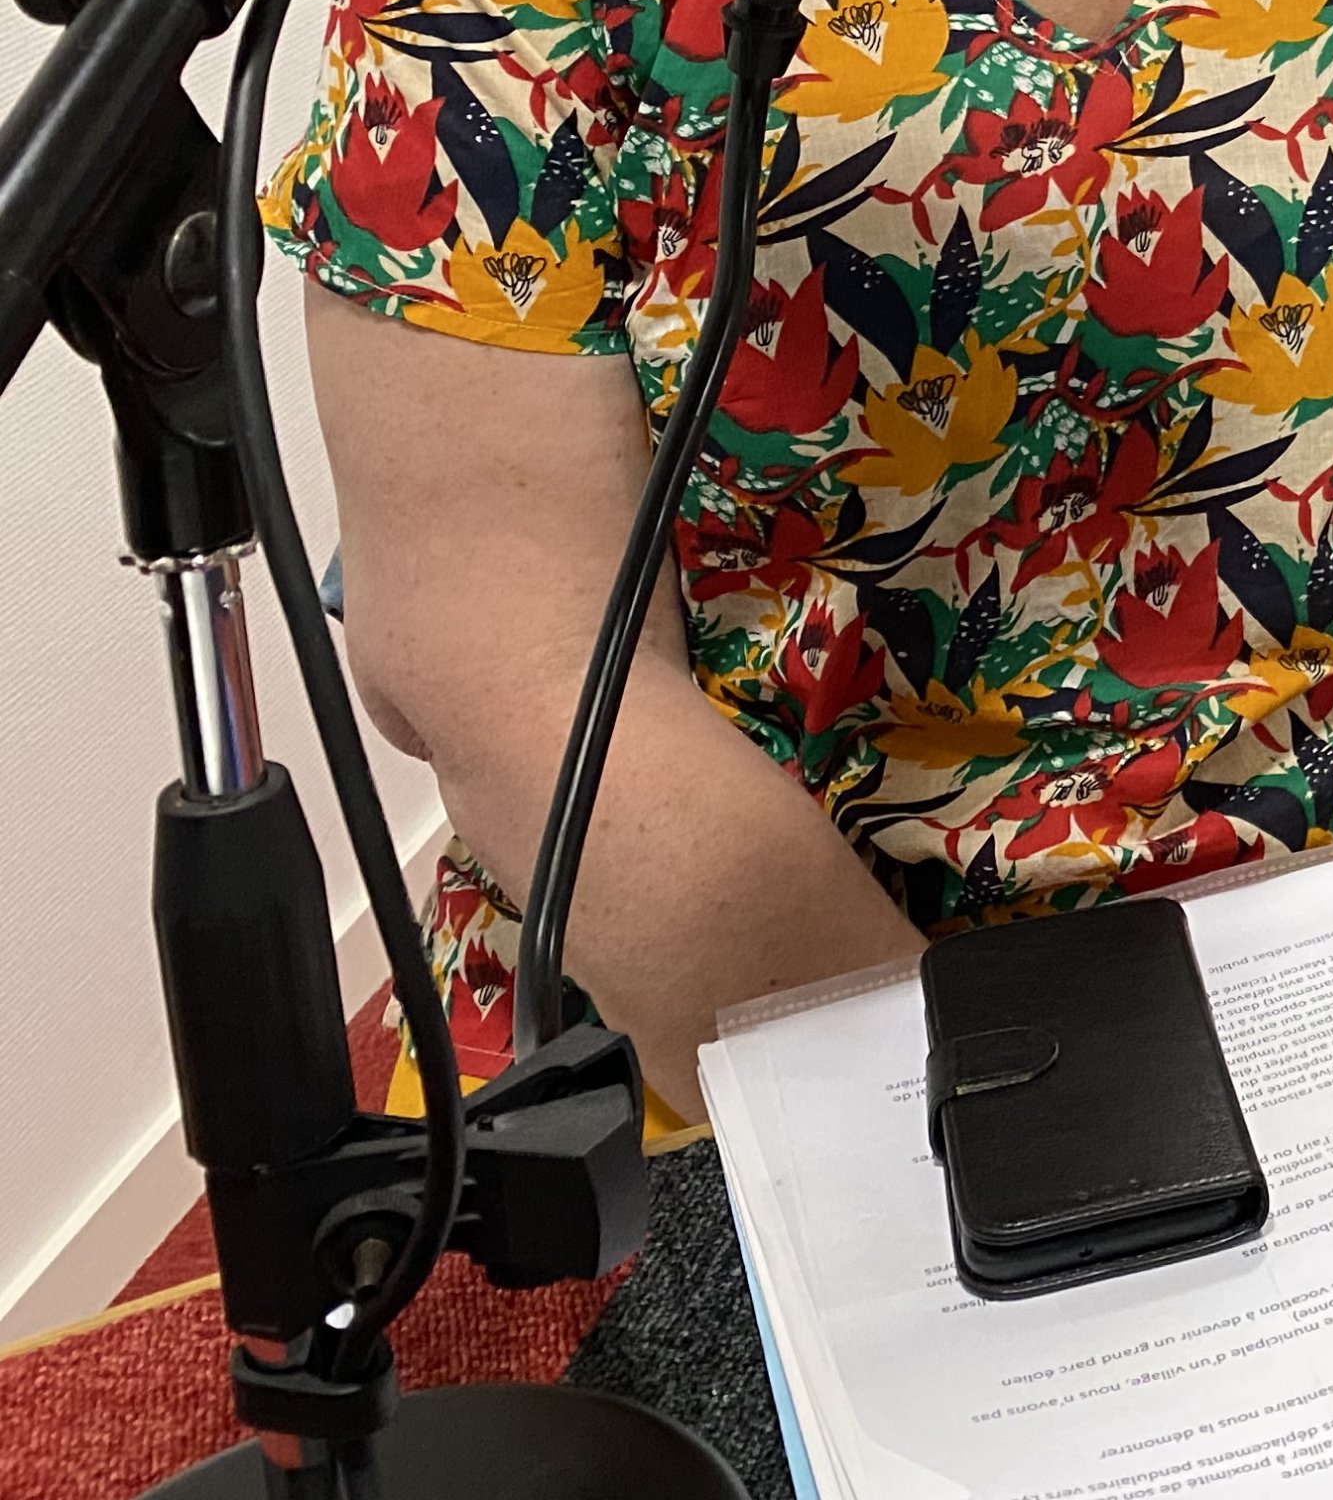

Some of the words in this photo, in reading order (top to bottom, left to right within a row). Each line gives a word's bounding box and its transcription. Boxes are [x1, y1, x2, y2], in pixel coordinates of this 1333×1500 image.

[1208, 955, 1248, 974] public
[1279, 957, 1325, 980] Marcel
[1277, 976, 1303, 990] avis
[1226, 1001, 1259, 1017] dans
[1249, 999, 1306, 1023] opposés
[1280, 1010, 1302, 1028] qui
[1259, 1020, 1277, 1031] en
[1309, 1012, 1333, 1028] pas
[1224, 1021, 1306, 1054] pro-carrière
[1310, 1041, 1328, 1053] au
[1263, 1048, 1307, 1070] Préfet
[1240, 1077, 1258, 1089] du
[1267, 1072, 1306, 1097] porté
[1241, 1086, 1263, 1102] par
[1267, 1150, 1322, 1176] amélior
[1273, 1147, 1292, 1160] ou
[1279, 1159, 1333, 1186] trouver
[1295, 1197, 1314, 1210] de
[1242, 1240, 1268, 1259] pas
[1259, 1285, 1328, 1316] vocation
[1181, 1315, 1241, 1342] devenir
[1230, 1320, 1319, 1358] municipale
[1101, 1340, 1149, 1367] grand
[1058, 1354, 1095, 1374] parc
[1001, 1368, 1054, 1387] éolien
[1218, 1409, 1259, 1428] nous
[1100, 1427, 1193, 1459] démontrer
[1197, 1426, 1317, 1469] déplacements
[1186, 1453, 1270, 1492] proximité
